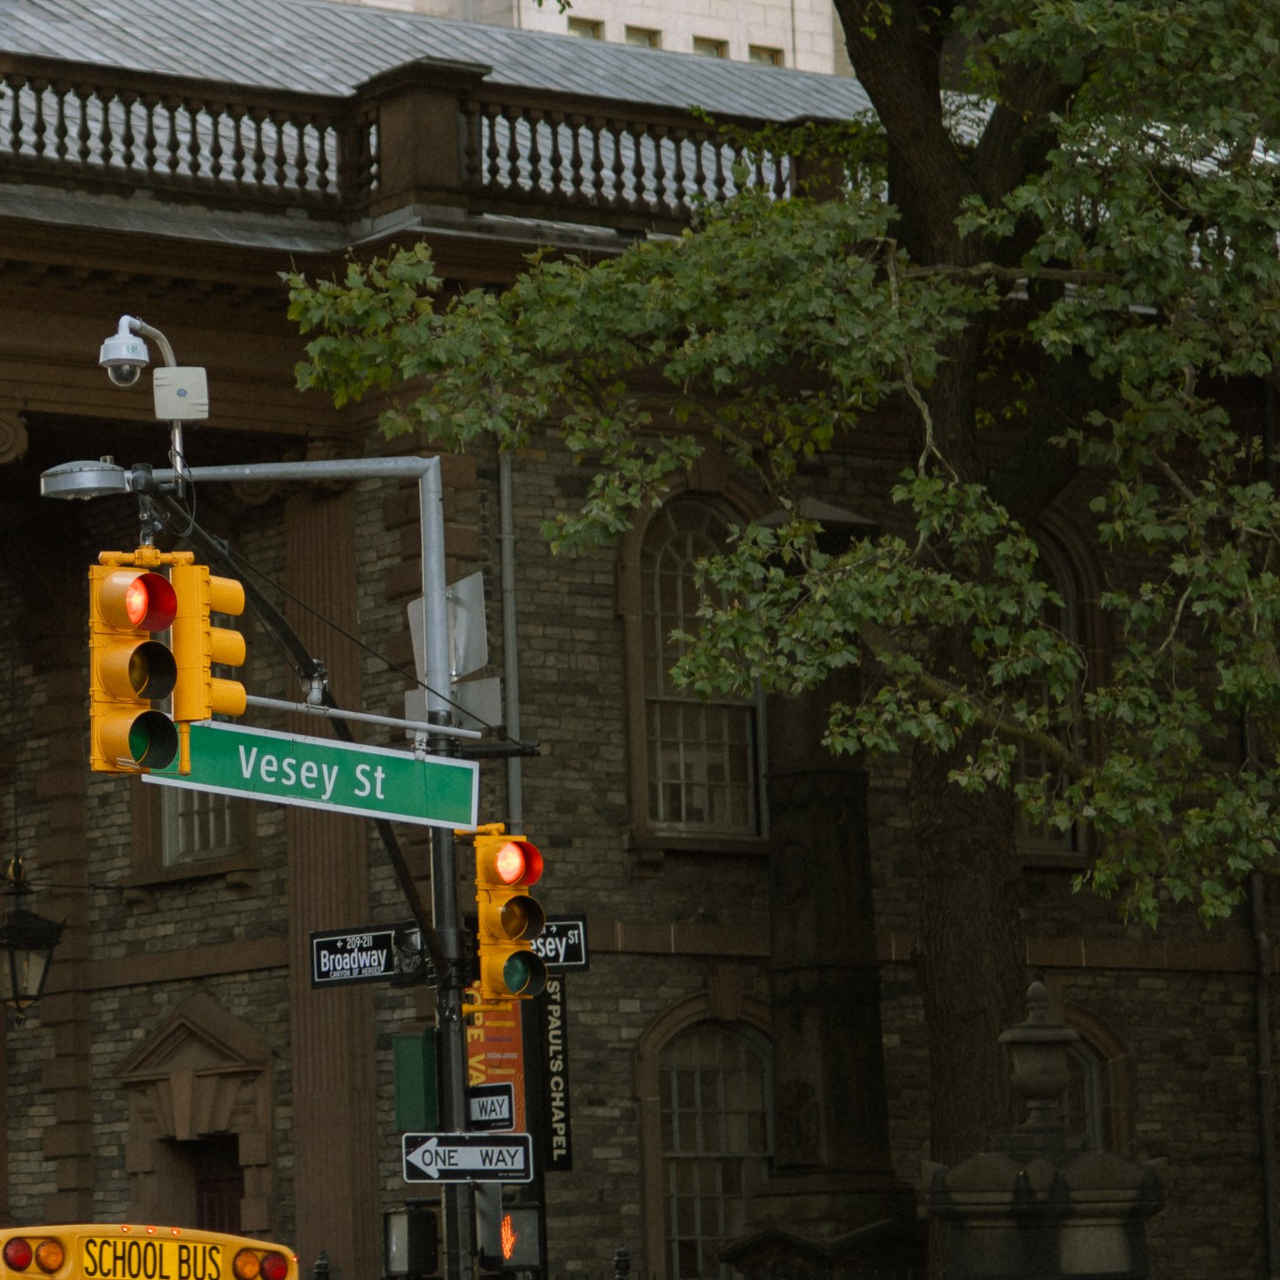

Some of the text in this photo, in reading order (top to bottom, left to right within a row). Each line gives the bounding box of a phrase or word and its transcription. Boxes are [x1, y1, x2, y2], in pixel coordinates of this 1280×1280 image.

[238, 744, 386, 800] Vesey St
[346, 935, 373, 949] 209-211
[529, 929, 579, 963] esey ST
[320, 948, 387, 972] Broadway
[546, 980, 567, 1161] ST PAUL'S CHAPEL
[477, 1098, 506, 1118] WAY
[421, 1149, 519, 1167] ONE WAY
[84, 1239, 170, 1280] SCHOOL
